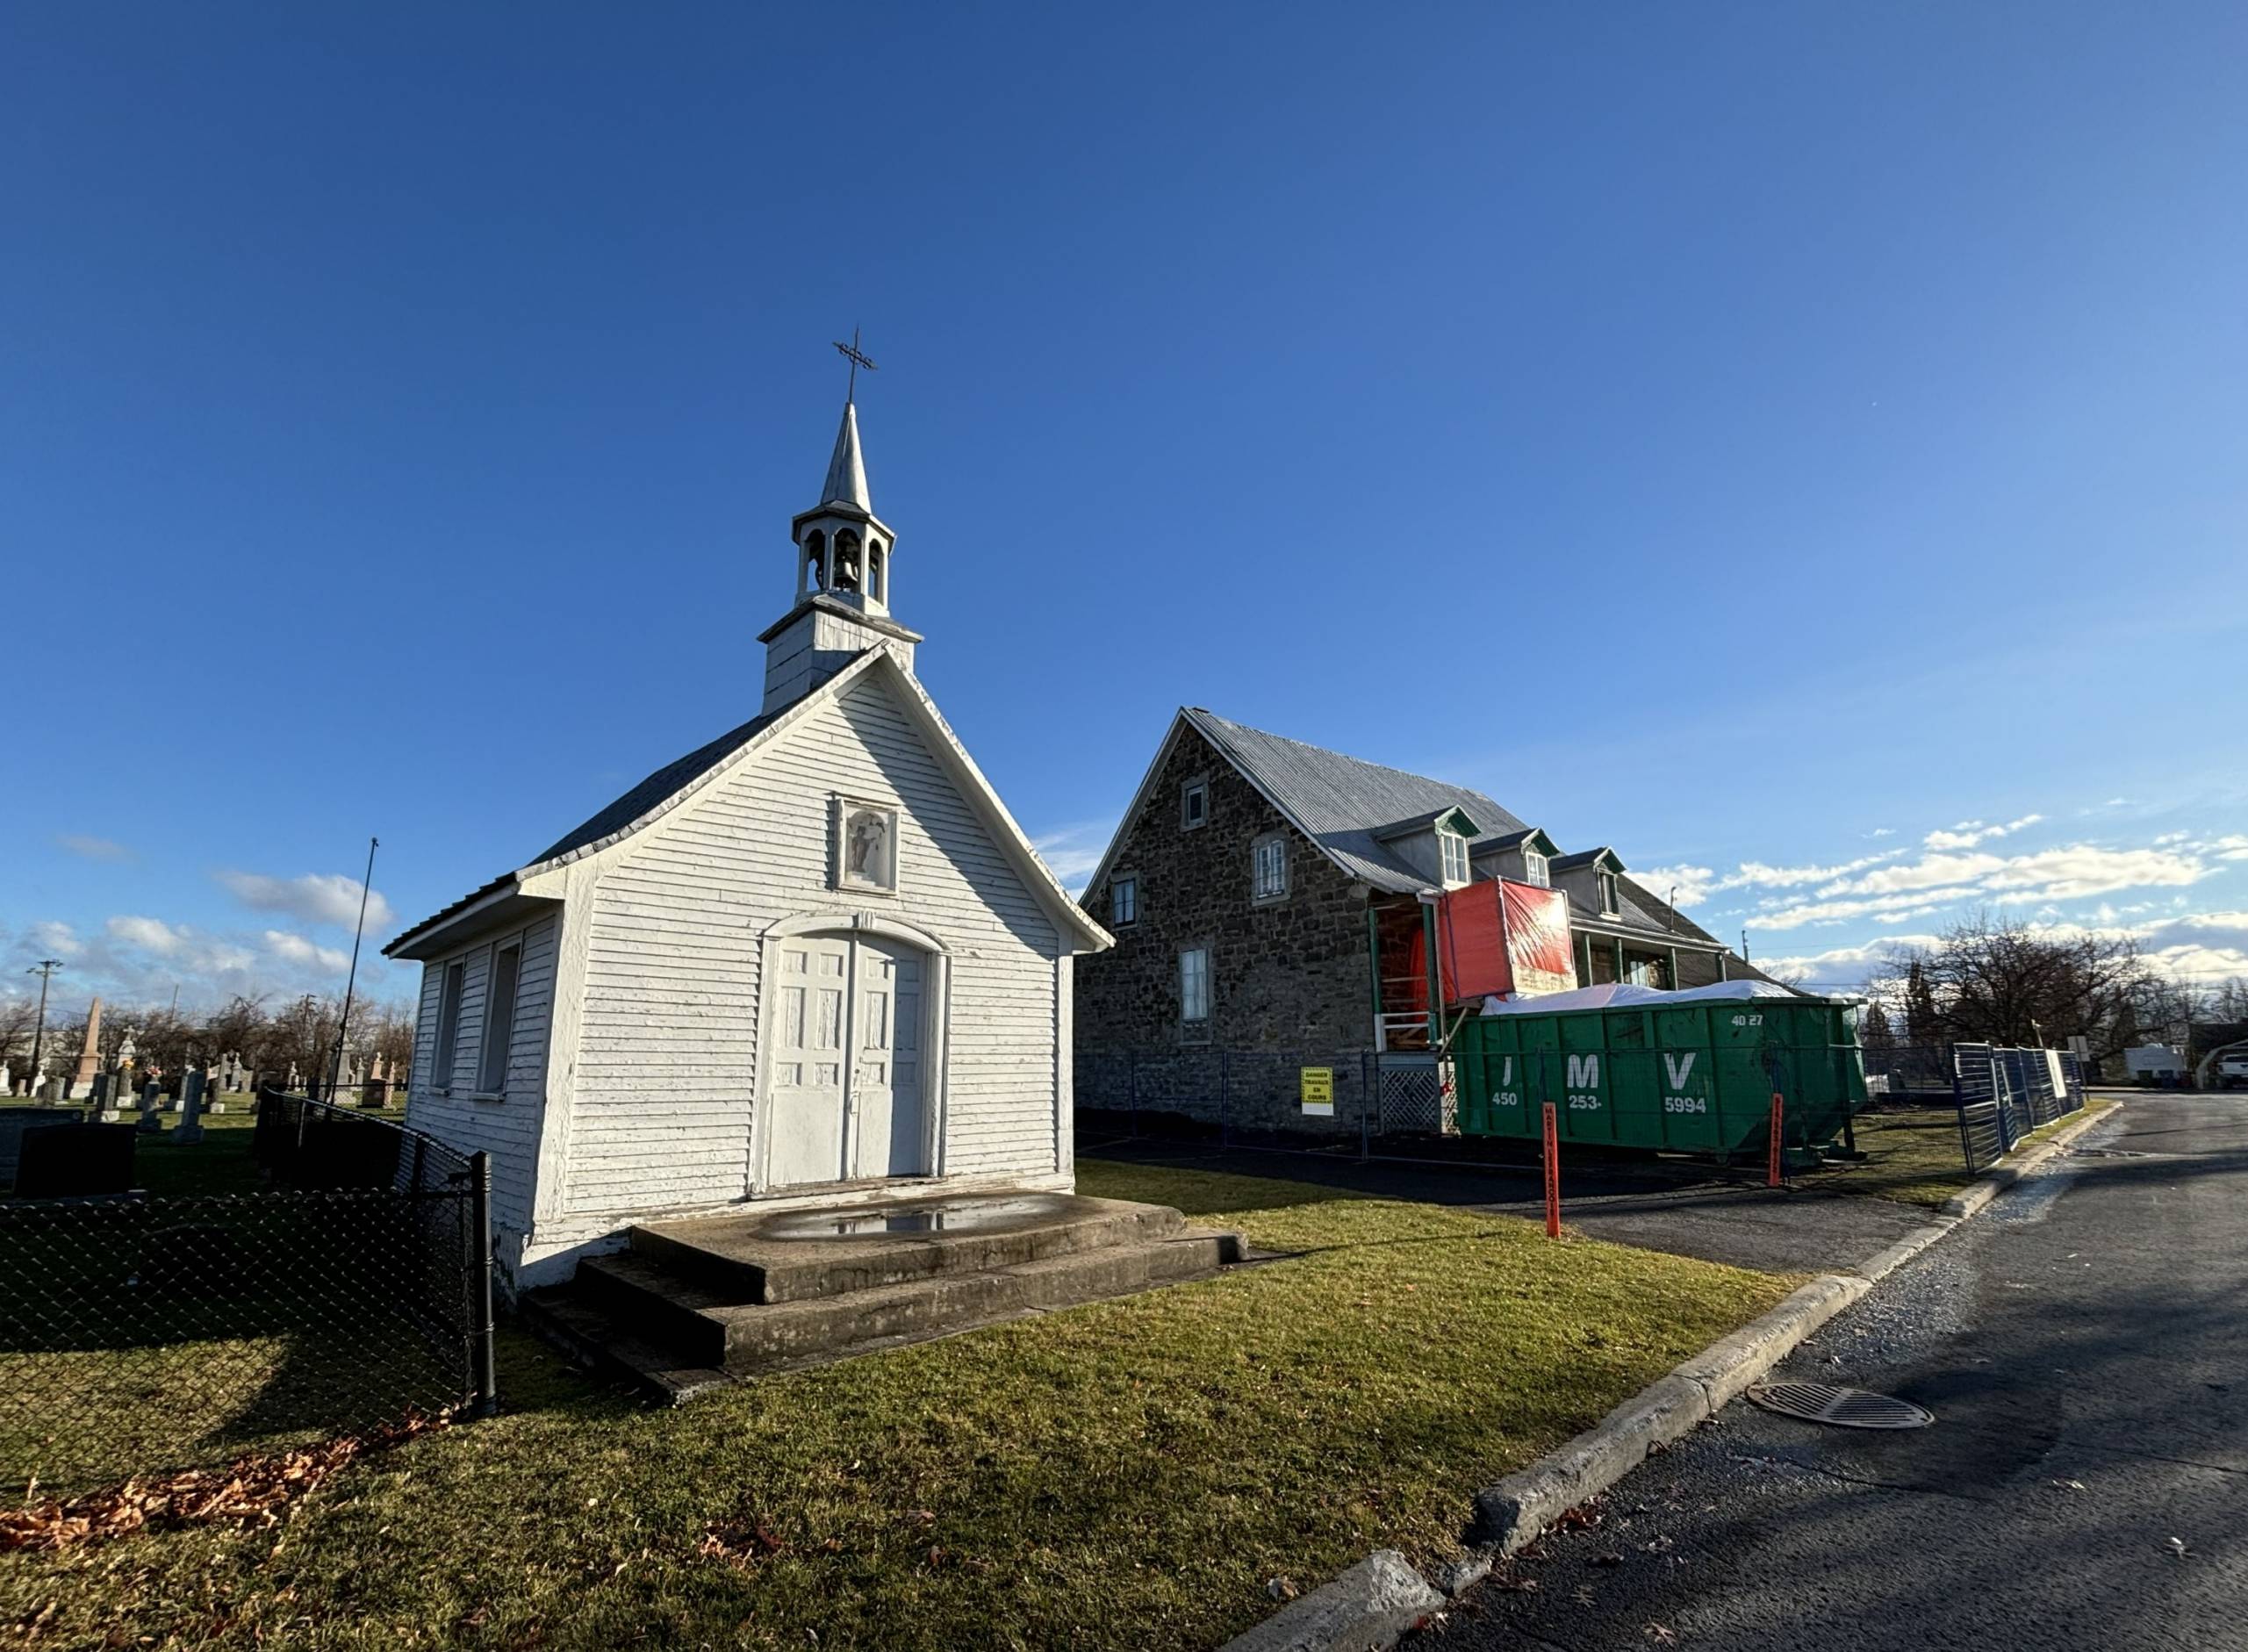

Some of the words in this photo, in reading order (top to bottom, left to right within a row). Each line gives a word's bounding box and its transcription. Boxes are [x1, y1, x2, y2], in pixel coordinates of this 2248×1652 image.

[1749, 1015, 1763, 1026] 27
[1503, 1056, 1512, 1087] J
[1567, 1054, 1598, 1088] M
[1663, 1052, 1697, 1090] V
[1492, 1092, 1517, 1106] 450
[1664, 1096, 1706, 1113] 5994
